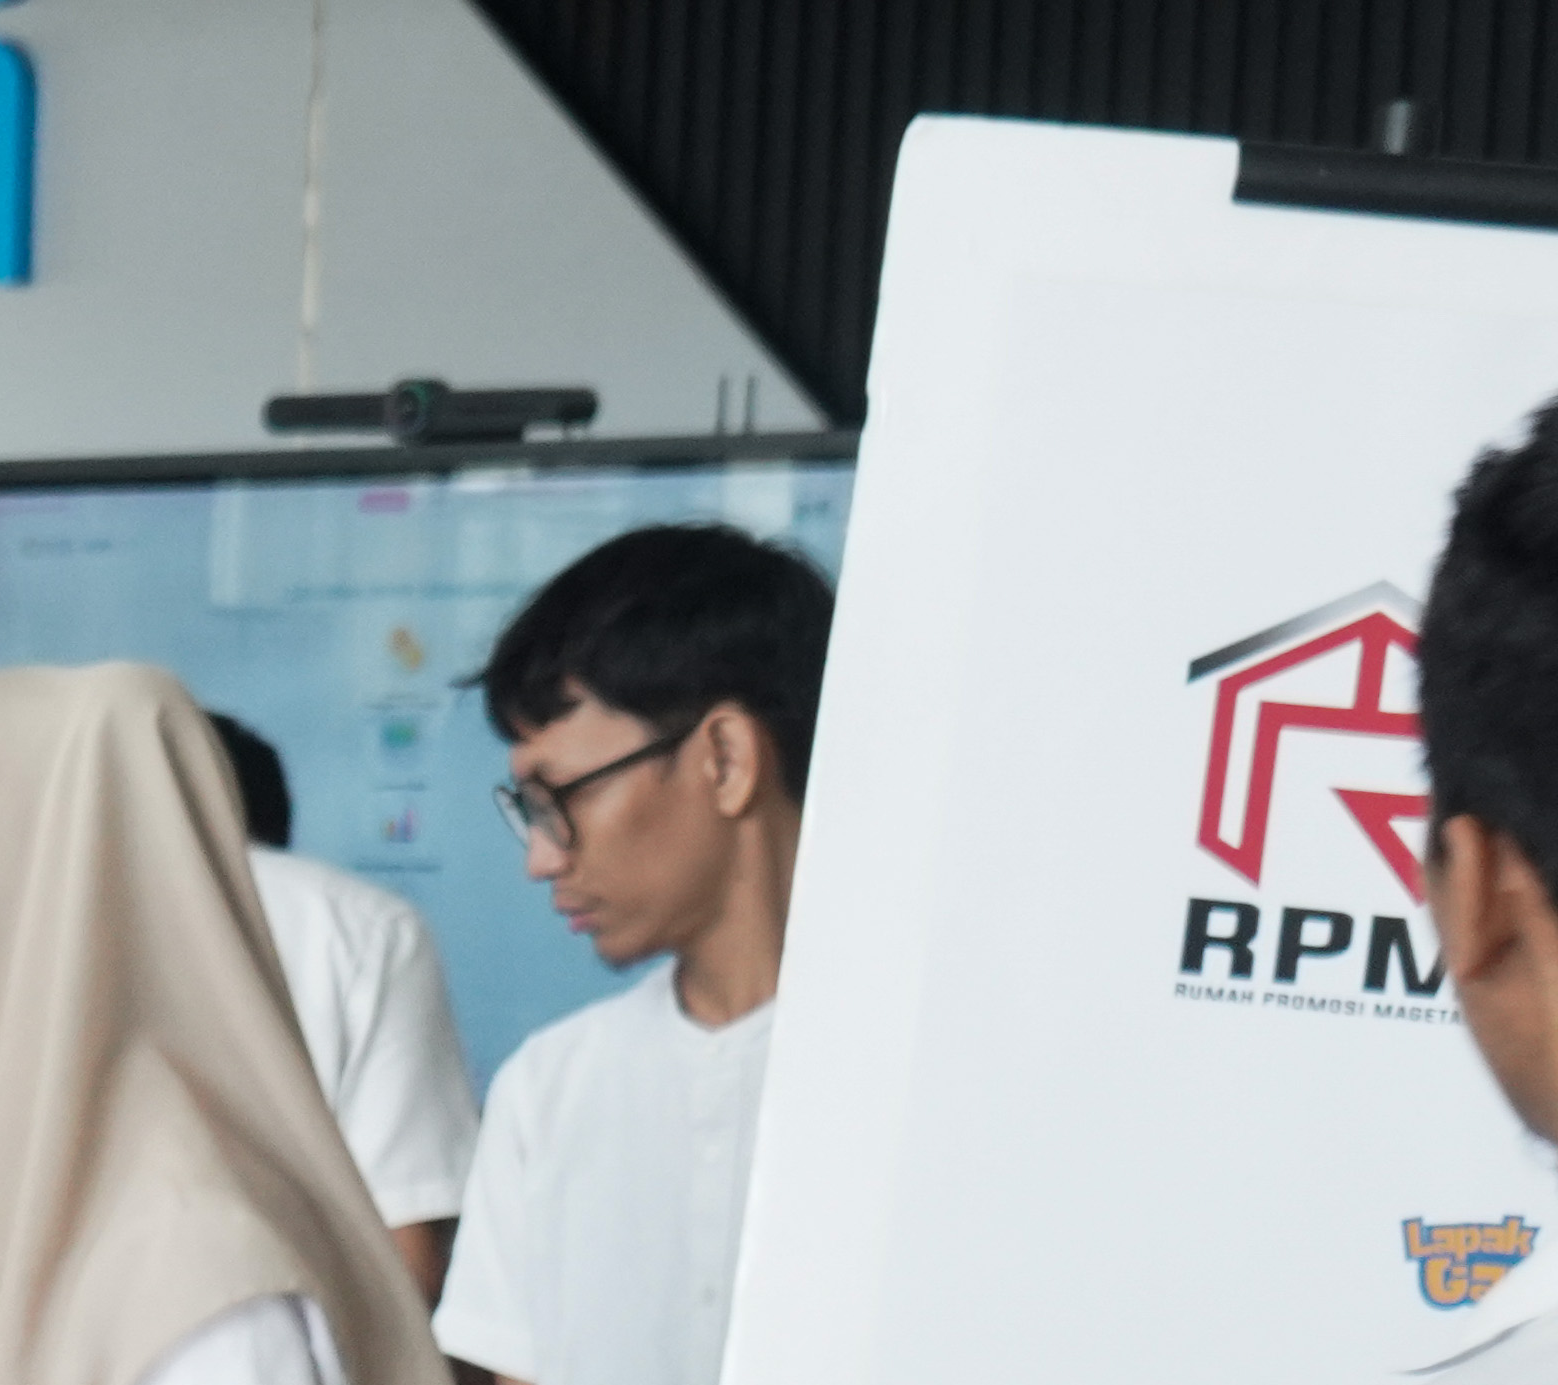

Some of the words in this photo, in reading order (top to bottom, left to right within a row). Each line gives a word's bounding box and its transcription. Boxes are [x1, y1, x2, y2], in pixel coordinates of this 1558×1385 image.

[1174, 982, 1254, 1004] RUMAH
[1263, 992, 1366, 1016] PROMOSI
[1404, 1217, 1535, 1262] Lapak
